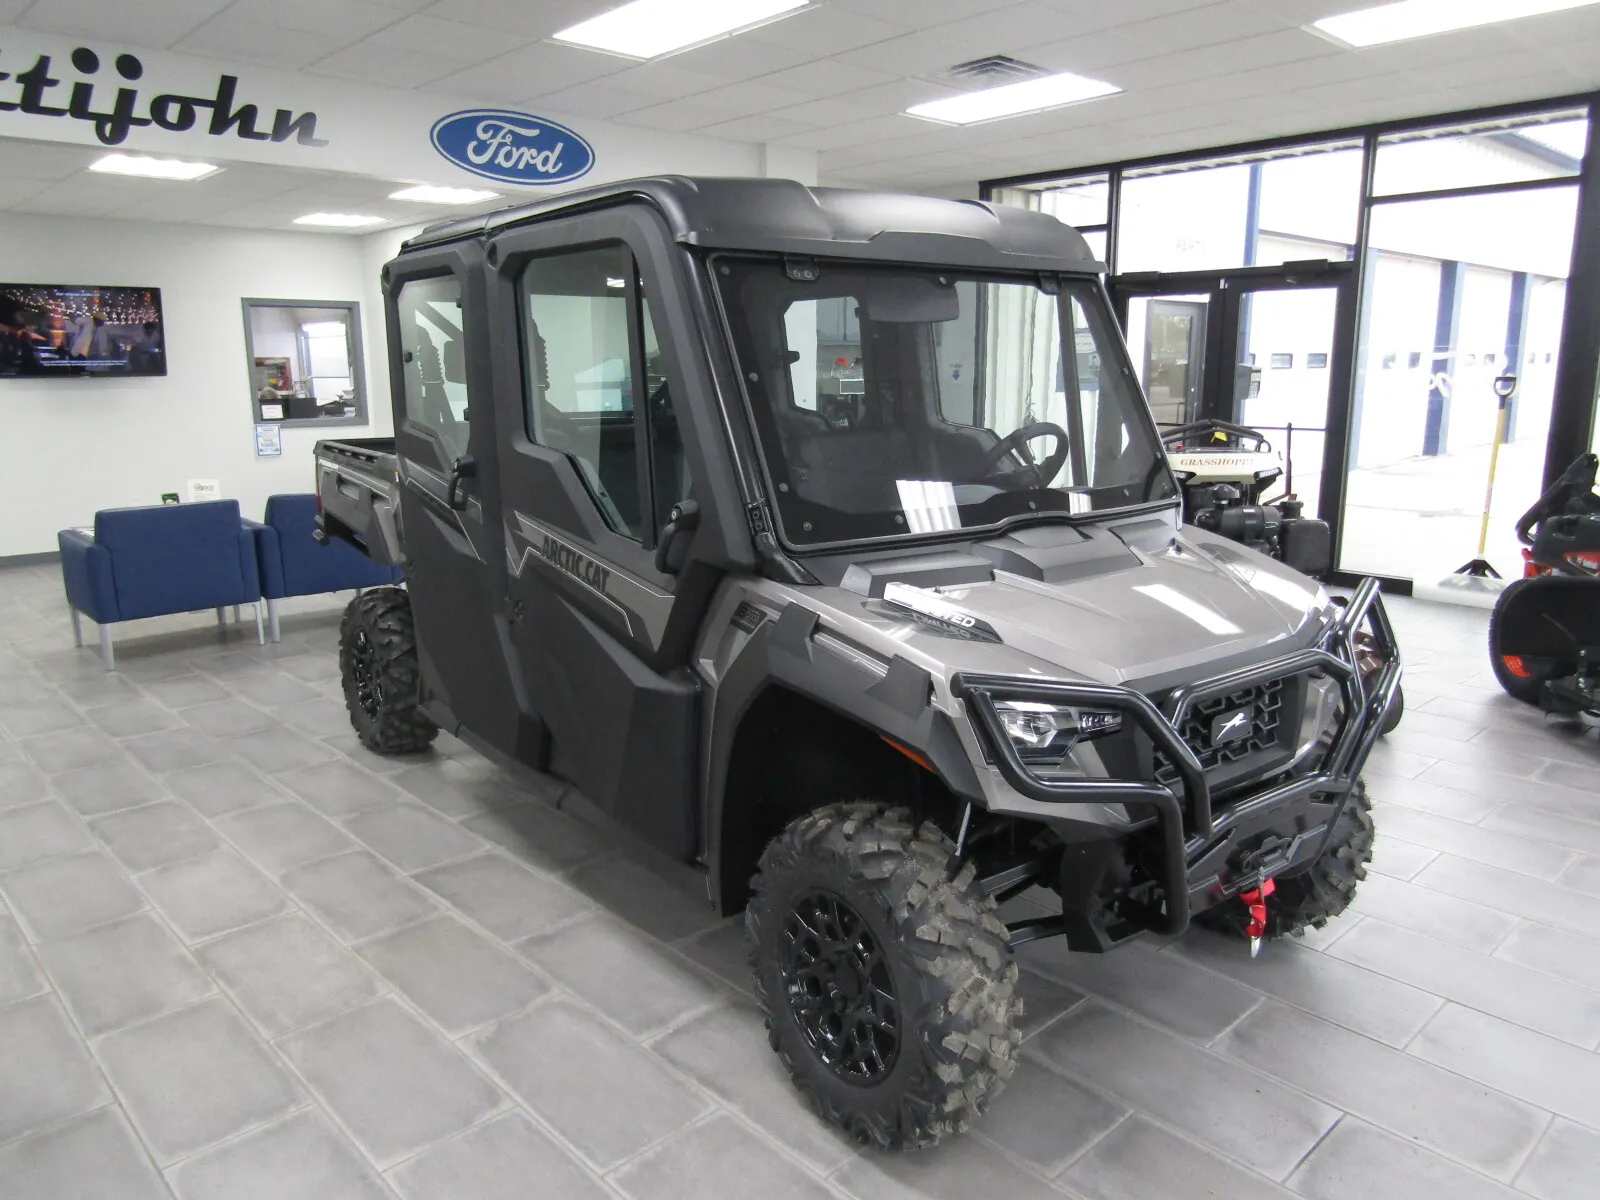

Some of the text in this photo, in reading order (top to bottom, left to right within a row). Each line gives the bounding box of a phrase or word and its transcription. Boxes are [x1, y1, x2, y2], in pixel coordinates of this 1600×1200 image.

[0, 47, 329, 146] tijohn
[467, 120, 564, 174] Ford
[541, 535, 610, 593] ARCTIC CAT
